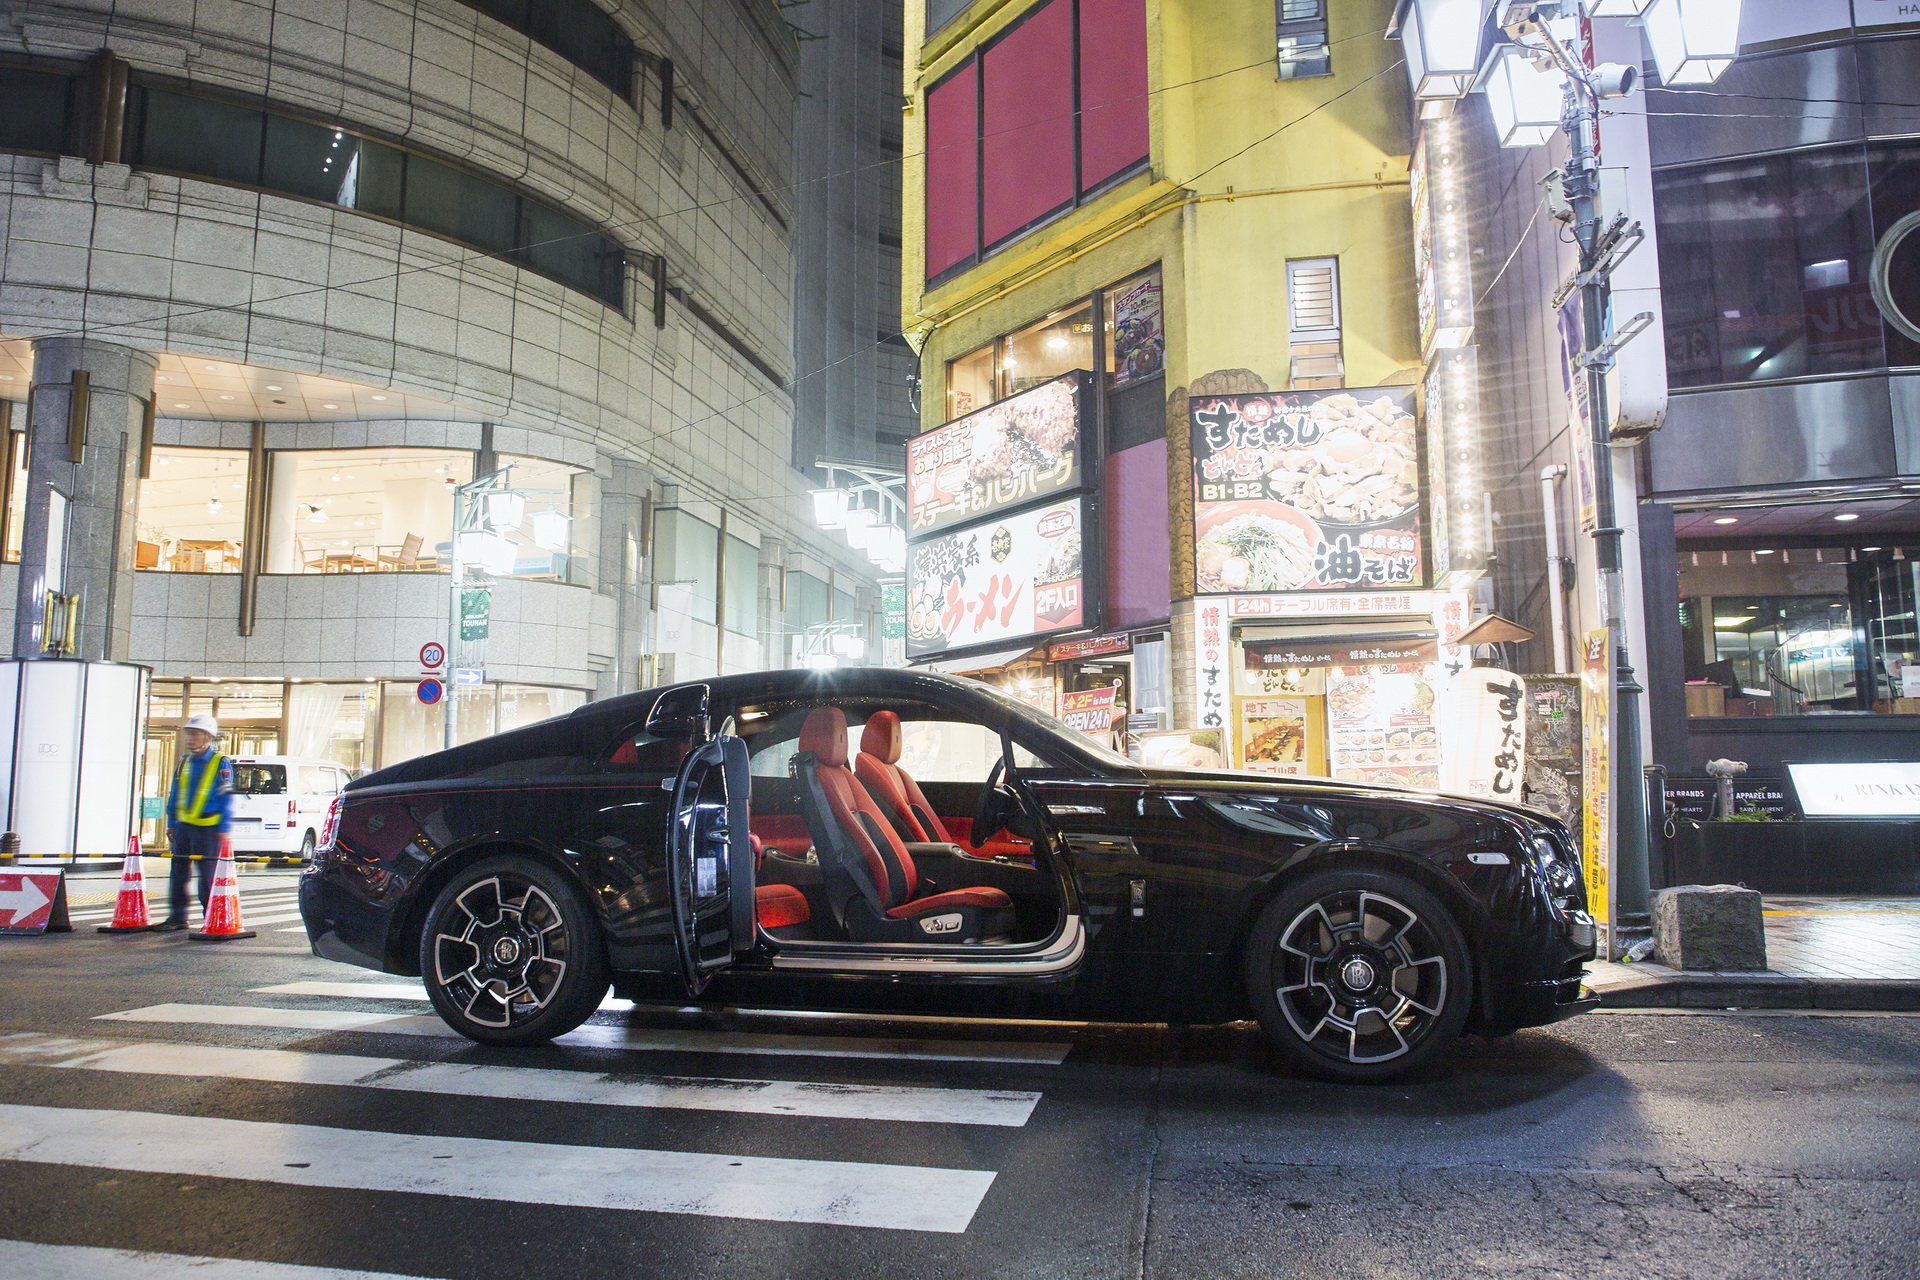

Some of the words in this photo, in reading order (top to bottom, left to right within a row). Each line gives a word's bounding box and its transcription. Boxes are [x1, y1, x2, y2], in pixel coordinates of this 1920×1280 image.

[1196, 402, 1325, 450] すためし
[1202, 451, 1264, 480] どんどん
[912, 450, 1074, 531] ステーキ&ハンバーグ
[914, 533, 980, 580] 横浜家系
[1359, 533, 1415, 551] 東京名物
[1314, 533, 1418, 586] 油そば
[941, 573, 1025, 640] ラーメン
[1035, 583, 1078, 615] 2F入口
[1236, 598, 1270, 614] 24h
[425, 649, 440, 662] 20
[1077, 693, 1094, 709] 2F
[1093, 695, 1100, 706] is
[1245, 702, 1268, 714] 地下
[1063, 711, 1089, 731] OPEN
[1485, 678, 1524, 795] すためし
[1736, 792, 1765, 800] APPAREL
